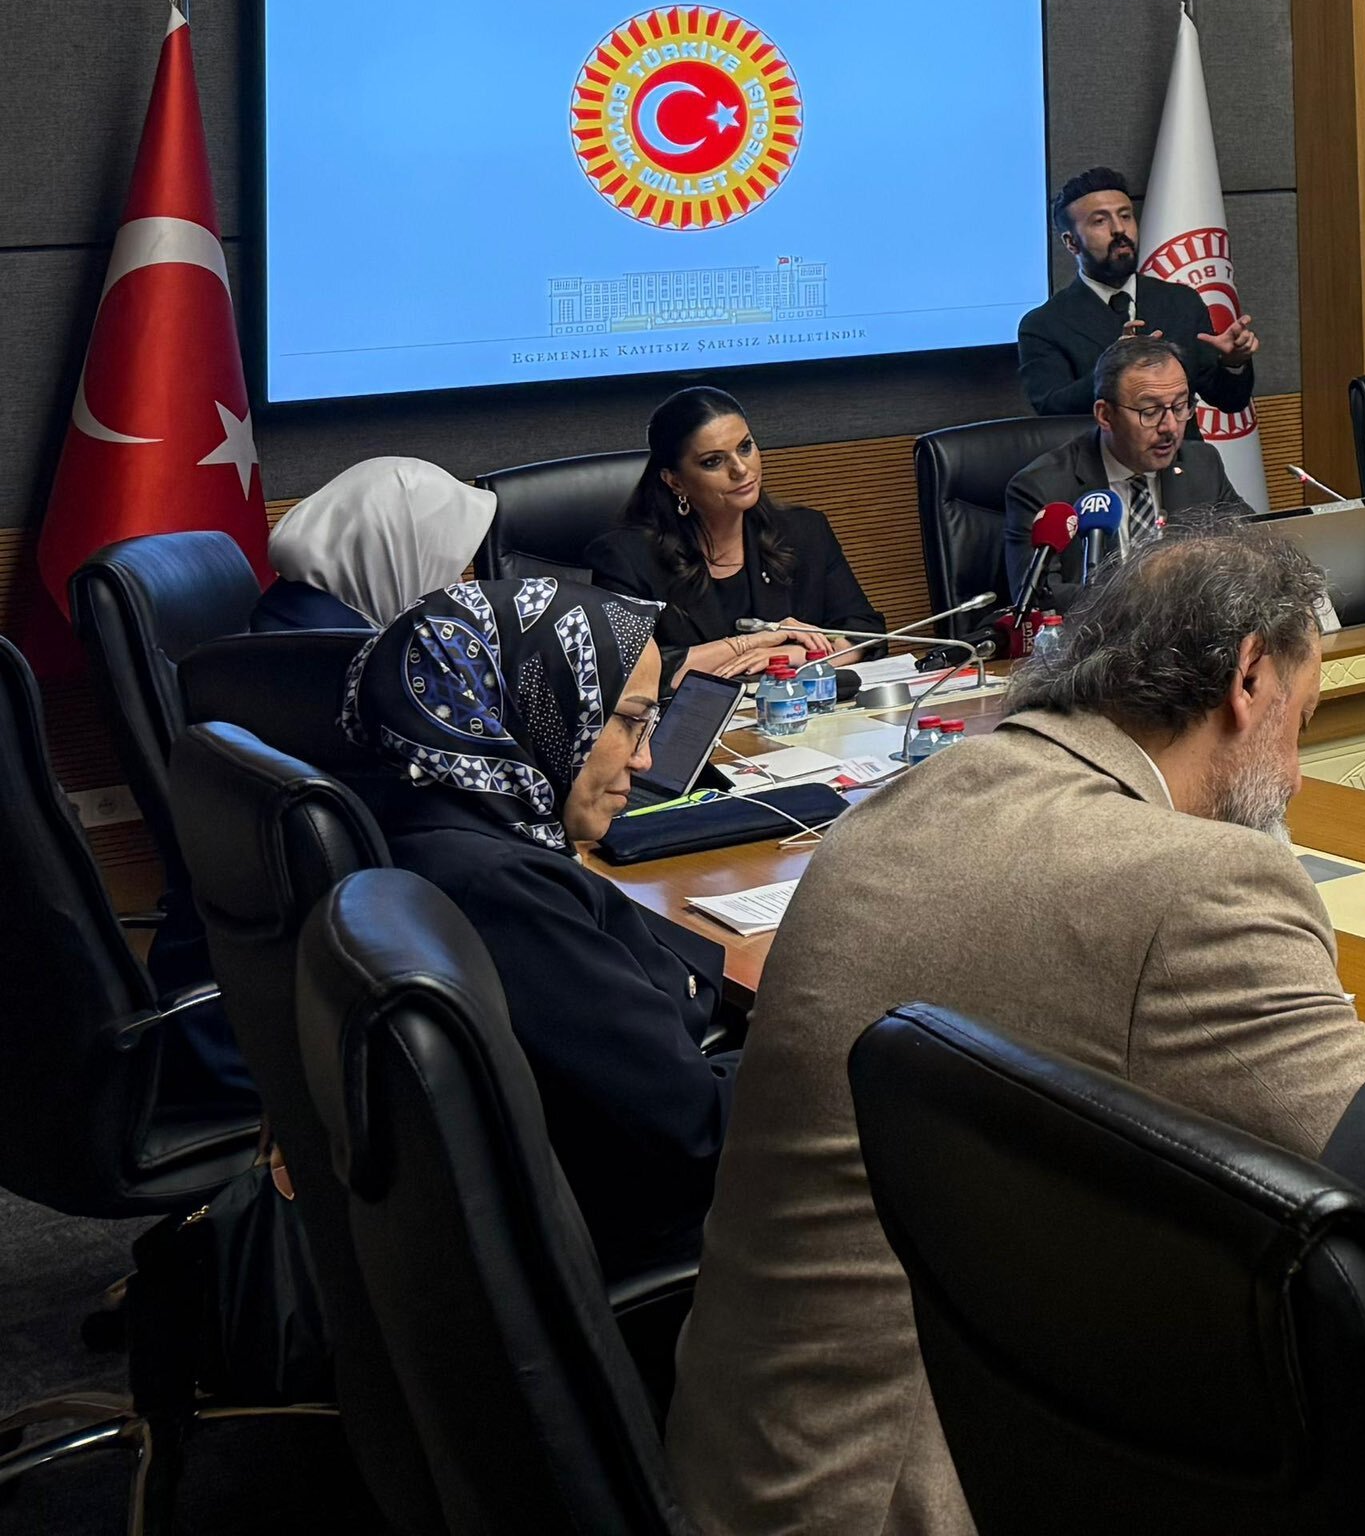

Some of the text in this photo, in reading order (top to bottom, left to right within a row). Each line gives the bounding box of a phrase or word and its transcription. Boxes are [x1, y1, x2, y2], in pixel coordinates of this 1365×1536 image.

[628, 41, 741, 78] TÜRKİYE
[608, 82, 640, 170] BÜYÜK
[638, 166, 728, 195] MİLLET
[1080, 492, 1110, 514] AA
